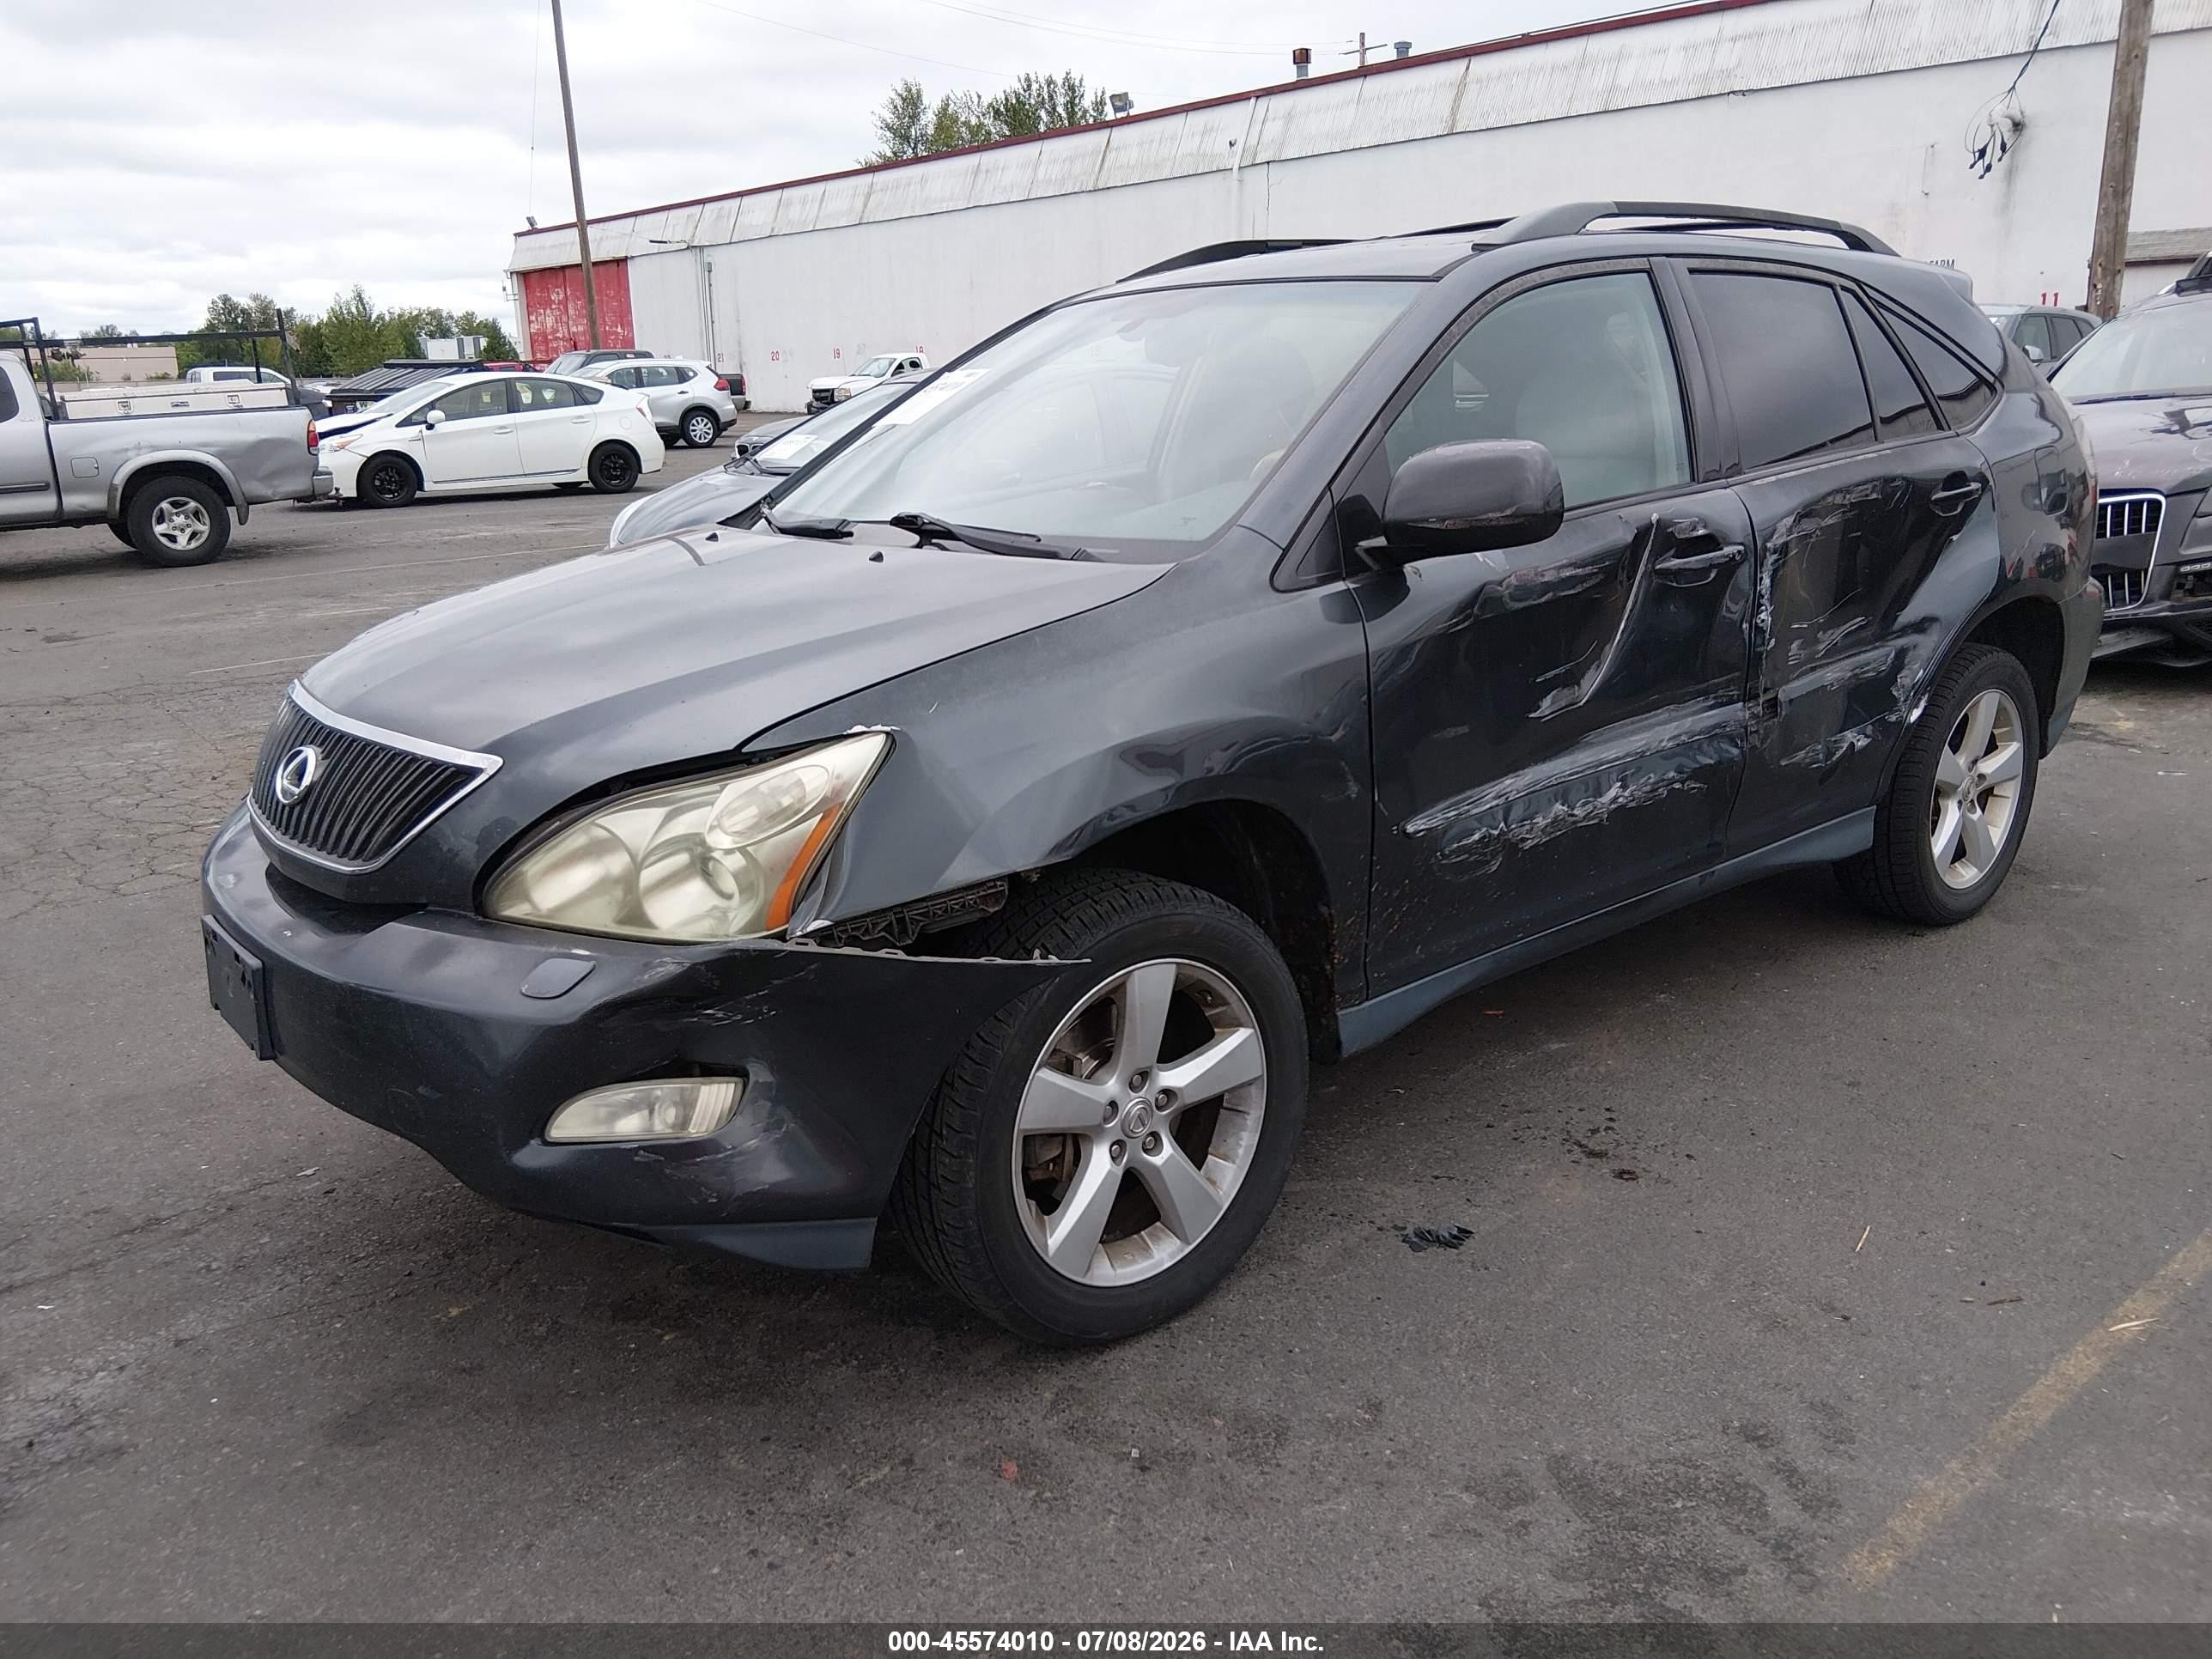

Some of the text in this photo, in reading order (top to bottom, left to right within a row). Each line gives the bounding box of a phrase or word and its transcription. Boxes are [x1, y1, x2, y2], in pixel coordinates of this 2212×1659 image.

[717, 352, 725, 362] 21
[770, 350, 780, 362] 20
[833, 347, 841, 359] 19
